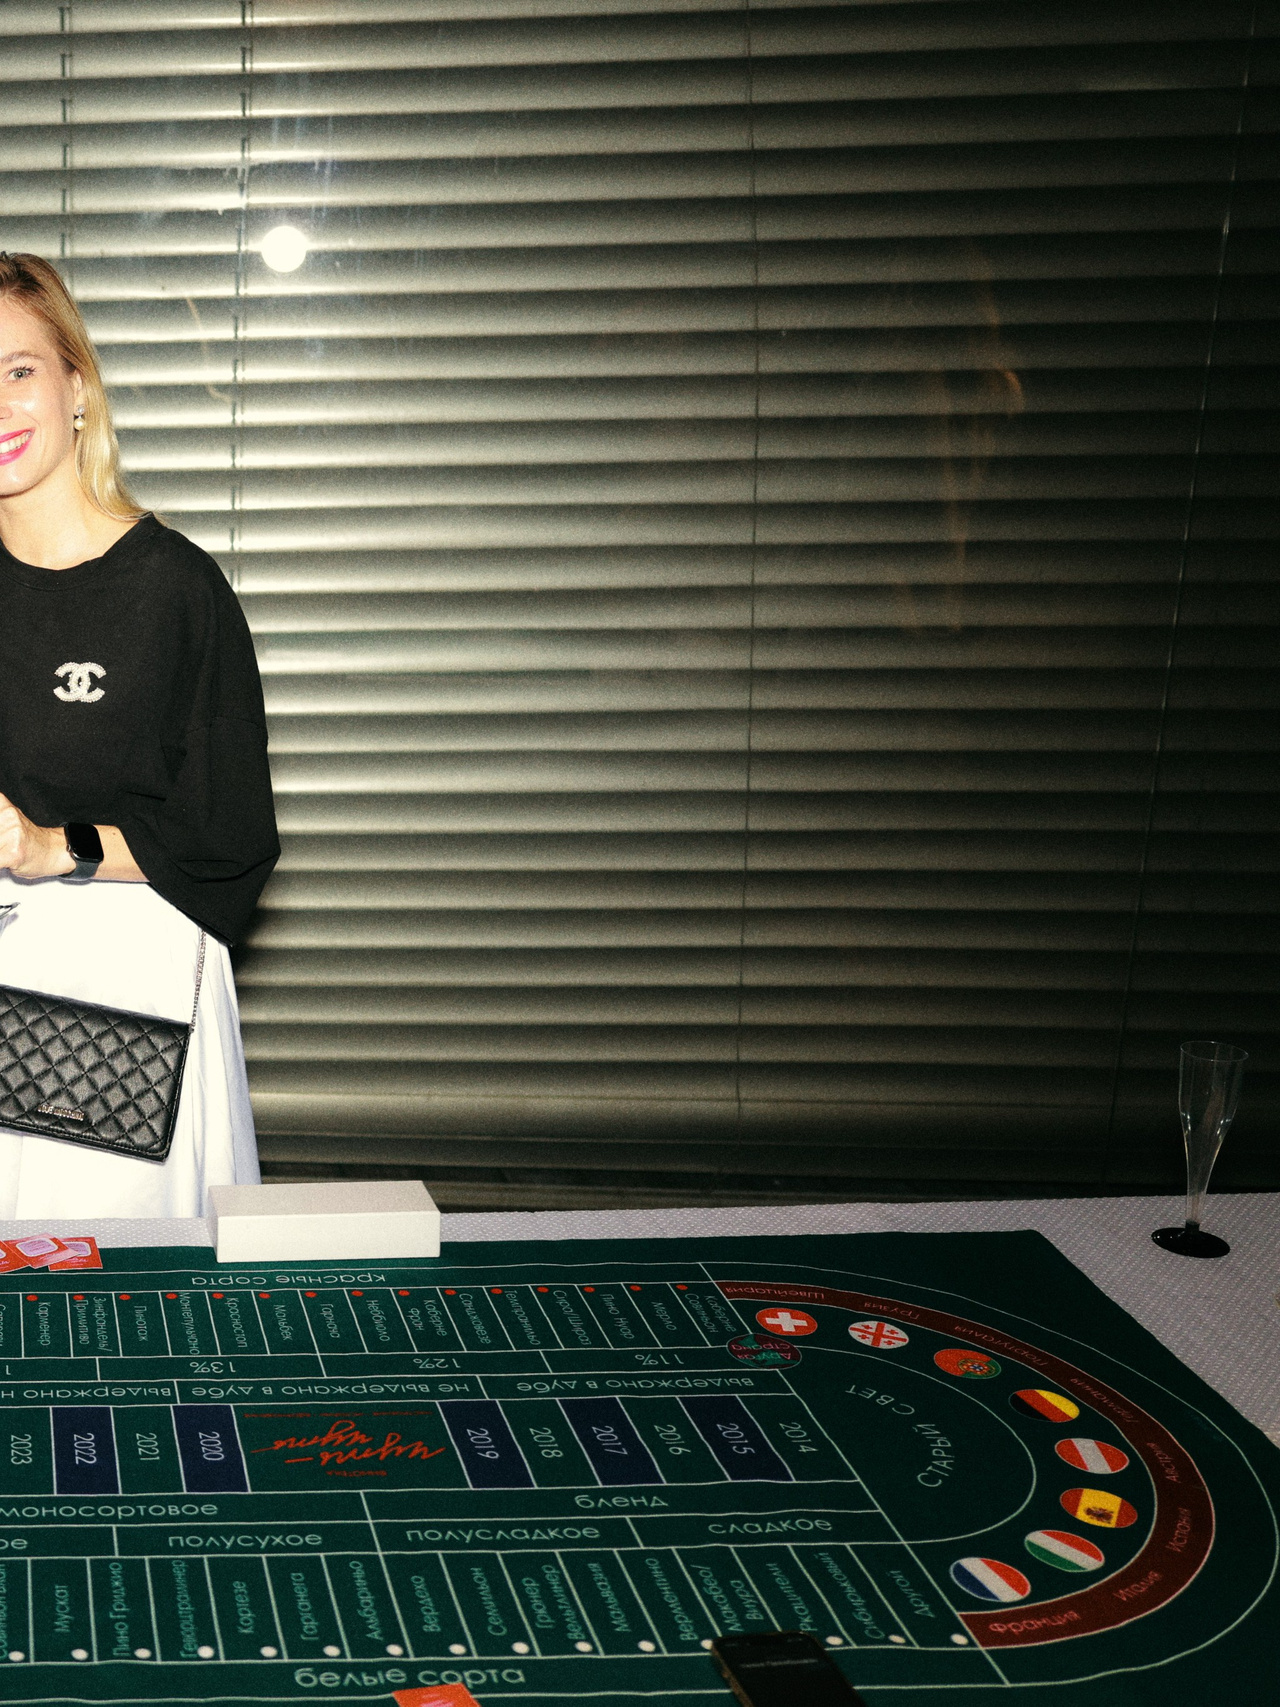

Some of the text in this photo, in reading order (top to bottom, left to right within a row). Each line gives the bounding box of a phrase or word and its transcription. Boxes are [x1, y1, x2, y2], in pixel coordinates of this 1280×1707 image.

[192, 1273, 386, 1286] красные сорта
[725, 1287, 824, 1300] Швейцария
[38, 1301, 52, 1346] Карменер
[77, 1299, 90, 1346] Примитиво
[92, 1296, 113, 1352] Зинфандель/
[134, 1305, 149, 1342] Пинотаж
[178, 1291, 201, 1356] Монтепульчано
[224, 1297, 248, 1348] Красностоп
[273, 1304, 293, 1342] Мальбек
[320, 1303, 341, 1339] Гарнача
[366, 1299, 391, 1342] Неббиоло
[423, 1299, 448, 1337] Каберне
[458, 1293, 492, 1345] Санджовезе
[504, 1290, 541, 1346] Темпранильо
[552, 1290, 592, 1346] Сира/Шираз
[600, 1293, 635, 1340] Пино Нуар
[651, 1301, 677, 1331] Мерло
[684, 1293, 720, 1334] Совиньон
[704, 1295, 737, 1333] Каберне
[864, 1303, 920, 1320] Грузия
[413, 1358, 461, 1369] 12%
[635, 1353, 685, 1365] 11%
[730, 1343, 791, 1351] страна
[736, 1352, 792, 1361] Другая
[954, 1325, 1049, 1367] Португалия
[189, 1361, 237, 1374] 13%
[516, 1377, 755, 1394] выдержано в дубе
[23, 1387, 171, 1399] выдержано
[191, 1383, 471, 1399] не выдержано в дубе
[1070, 1376, 1139, 1424] Германия
[10, 1433, 33, 1465] 2023
[73, 1432, 97, 1465] 2022
[135, 1432, 161, 1461] 2021
[198, 1431, 225, 1461] 2020
[466, 1427, 499, 1460] 2019
[529, 1427, 563, 1459] 2018
[592, 1425, 628, 1457] 2017
[654, 1424, 691, 1455] 2016
[716, 1422, 755, 1455] 2015
[779, 1422, 818, 1454] 2014
[844, 1383, 956, 1488] СТАРЫЙ СВЕТ
[575, 1495, 668, 1509] бленд
[168, 1533, 323, 1549] полусухое
[406, 1524, 600, 1545] полусладкое
[708, 1518, 833, 1534] сладкое
[1166, 1507, 1192, 1552] Испания
[348, 1560, 384, 1641] Альбариньо
[410, 1575, 441, 1633] Вердехо
[470, 1567, 507, 1637] Семильон
[521, 1576, 555, 1629] Грюнер
[541, 1564, 586, 1640] Вельтлинер
[587, 1562, 632, 1632] Мальвазия
[645, 1558, 699, 1641] Верментино
[690, 1563, 744, 1632] Макабео/
[730, 1579, 765, 1621] Виура
[765, 1562, 818, 1632] Ркацители
[814, 1552, 885, 1640] Сибирьковый
[888, 1569, 935, 1619] Другой
[1113, 1570, 1164, 1602] Италия
[54, 1584, 74, 1633] Мускат
[109, 1562, 131, 1657] Пино Гриджио
[232, 1581, 255, 1634] Кортезе
[290, 1572, 319, 1641] Гарганега
[989, 1610, 1081, 1635] Франция
[294, 1668, 526, 1691] белые сорта
